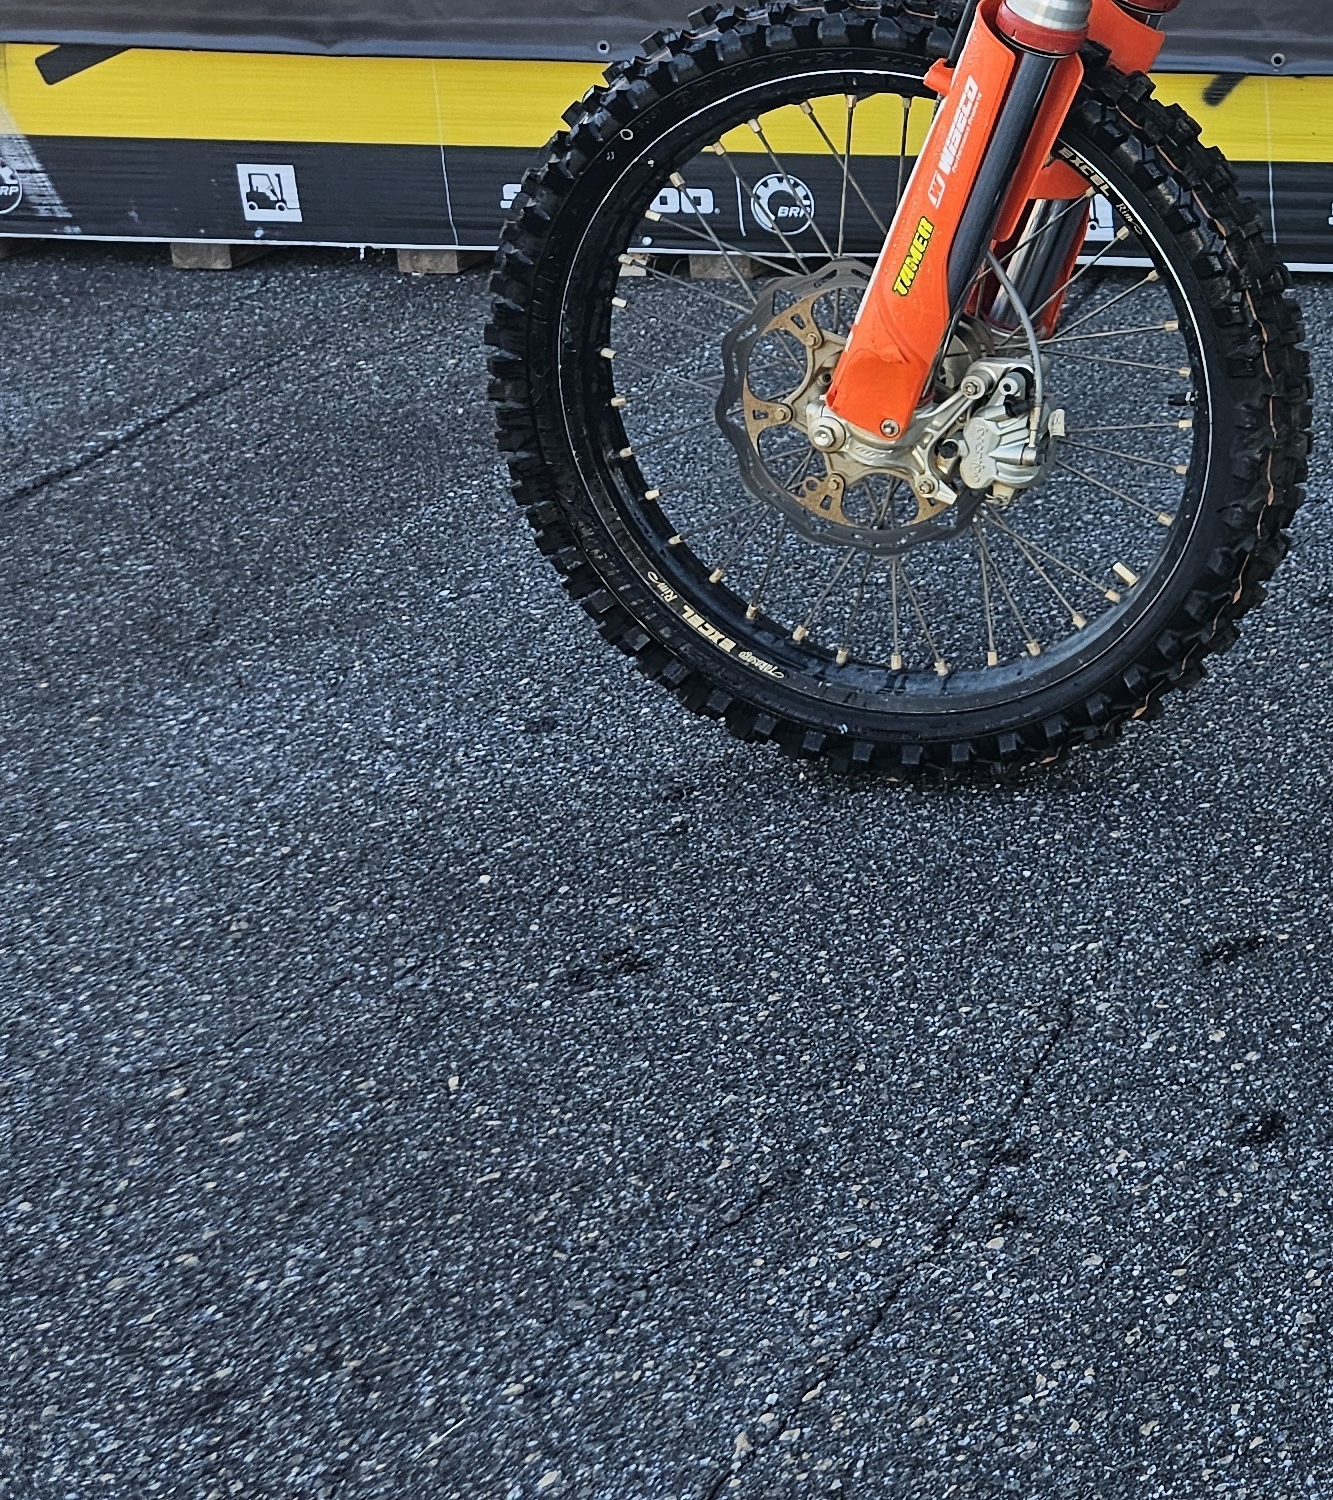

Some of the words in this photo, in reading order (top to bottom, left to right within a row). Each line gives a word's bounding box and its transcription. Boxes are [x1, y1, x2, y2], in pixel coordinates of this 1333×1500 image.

[1058, 147, 1110, 197] EXCEL
[1115, 203, 1143, 235] Rim
[648, 571, 678, 603] Rim
[682, 605, 737, 652] EXCEL
